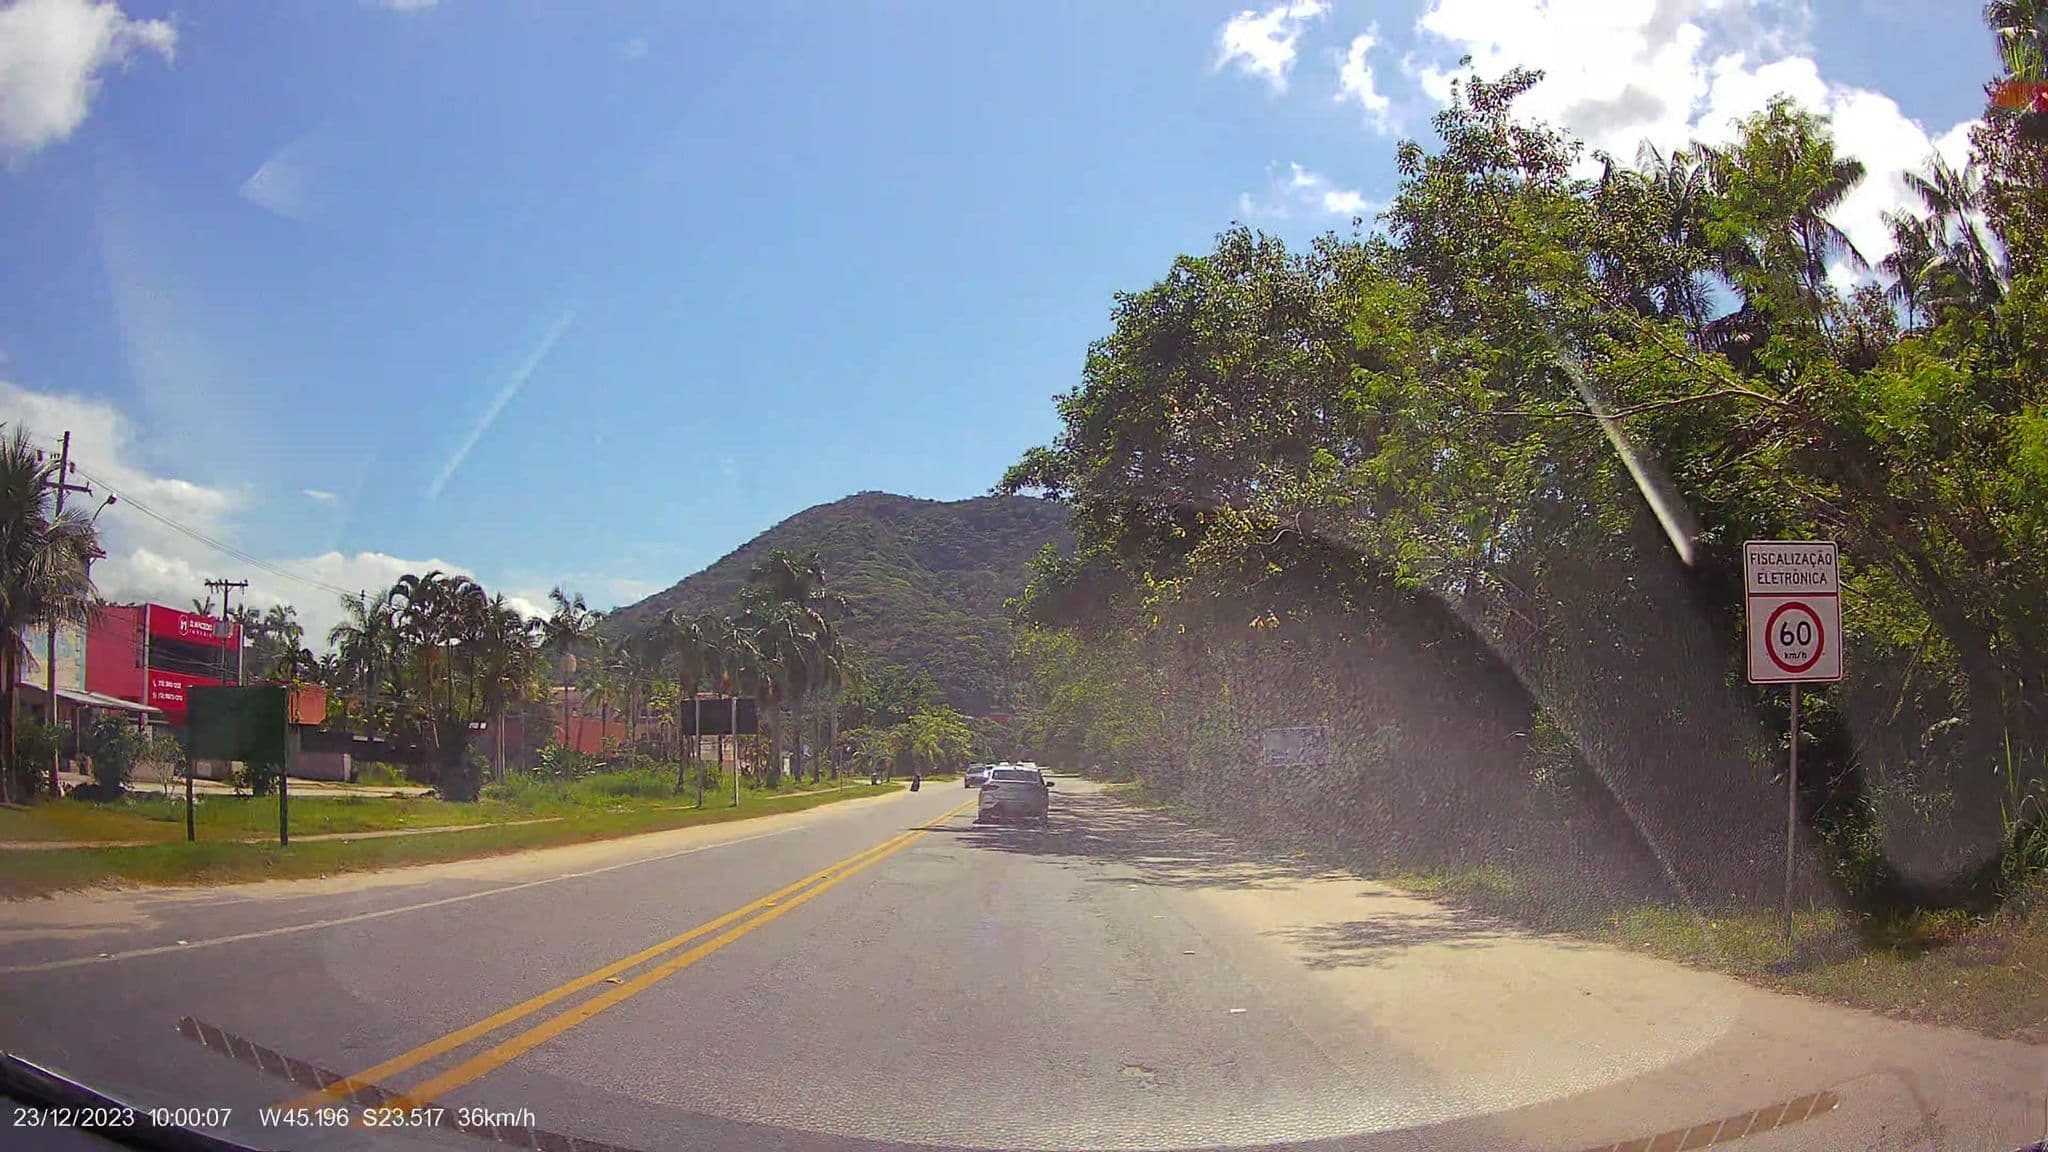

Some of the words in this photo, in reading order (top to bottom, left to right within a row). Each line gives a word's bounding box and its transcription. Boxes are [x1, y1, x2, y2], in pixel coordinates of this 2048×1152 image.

[1750, 551, 1832, 567] FISCALIZAÇÃO
[1757, 569, 1828, 585] ELETRÔNICA
[1780, 621, 1812, 646] 60
[1784, 651, 1807, 660] km/h
